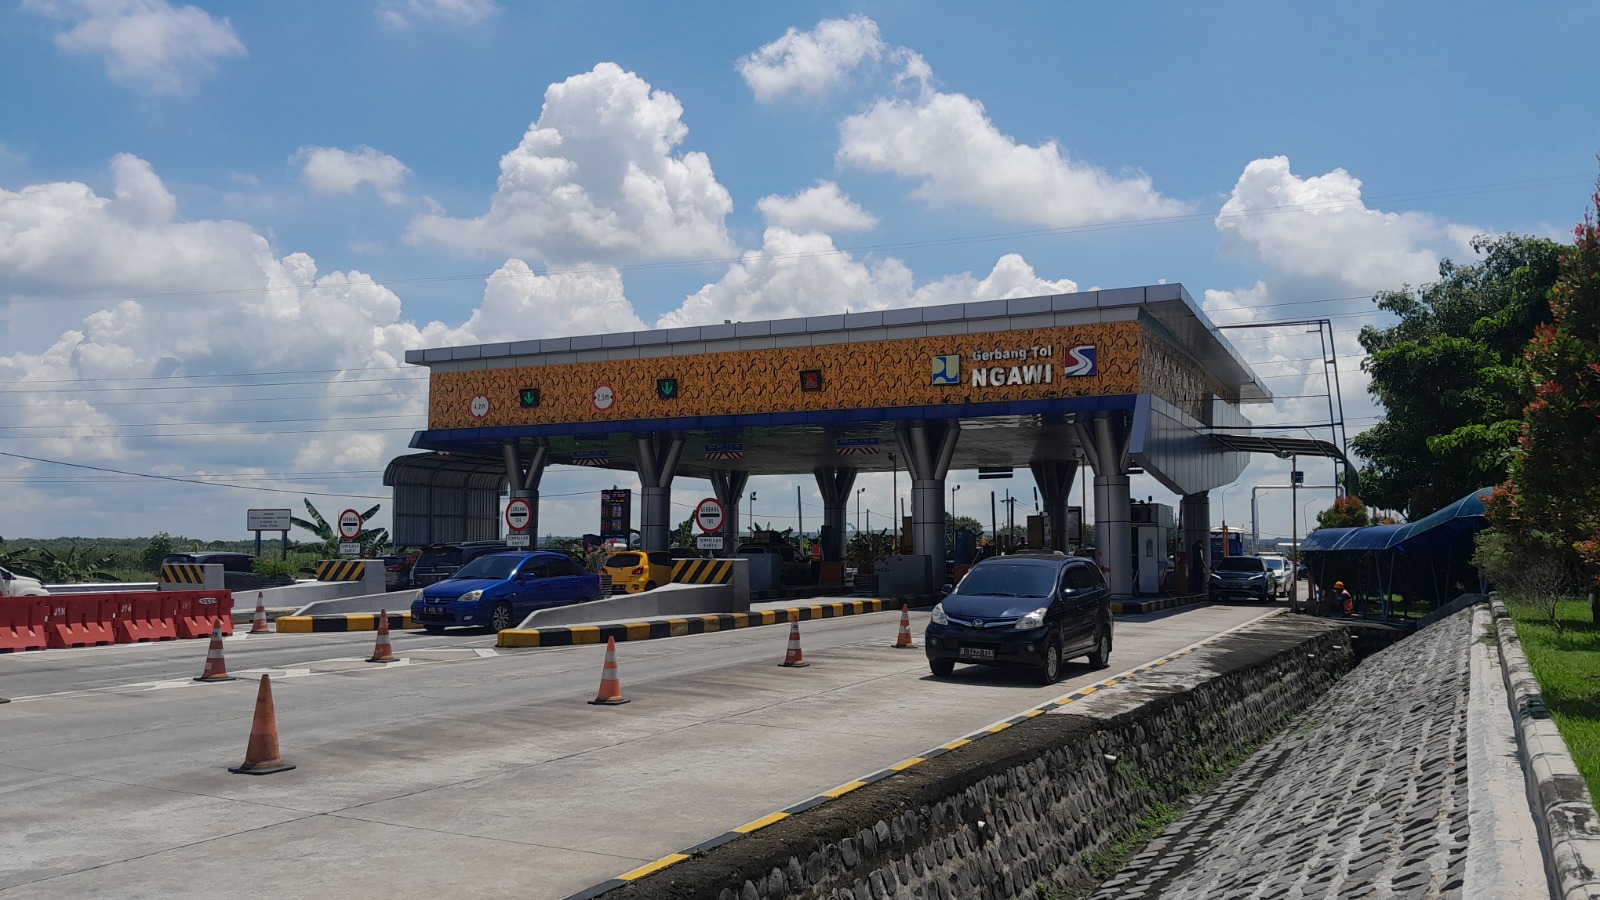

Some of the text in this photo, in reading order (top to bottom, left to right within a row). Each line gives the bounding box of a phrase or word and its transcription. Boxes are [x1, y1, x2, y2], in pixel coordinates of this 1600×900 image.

[973, 345, 1052, 361] Gerbang Tol
[972, 364, 1052, 387] NGAWI
